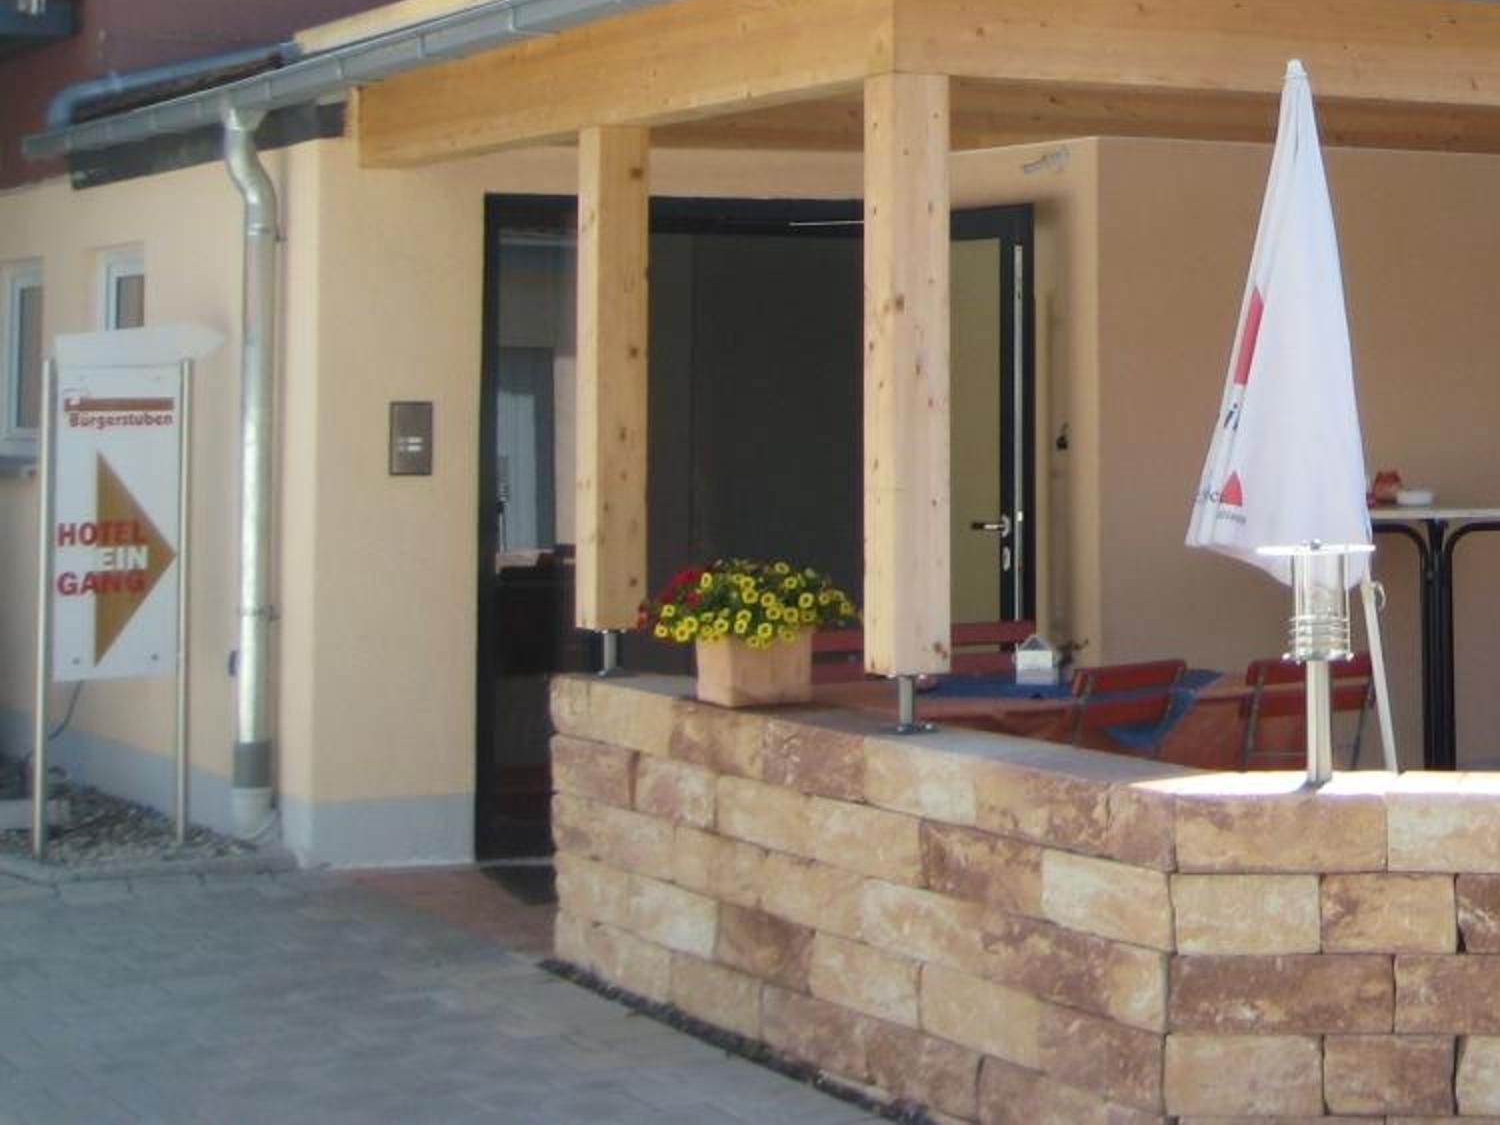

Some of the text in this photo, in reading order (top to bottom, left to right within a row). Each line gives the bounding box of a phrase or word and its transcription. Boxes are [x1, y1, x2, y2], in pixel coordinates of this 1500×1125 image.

[57, 522, 149, 546] HOTEL
[102, 547, 148, 570] EIN
[57, 571, 146, 595] GANG
